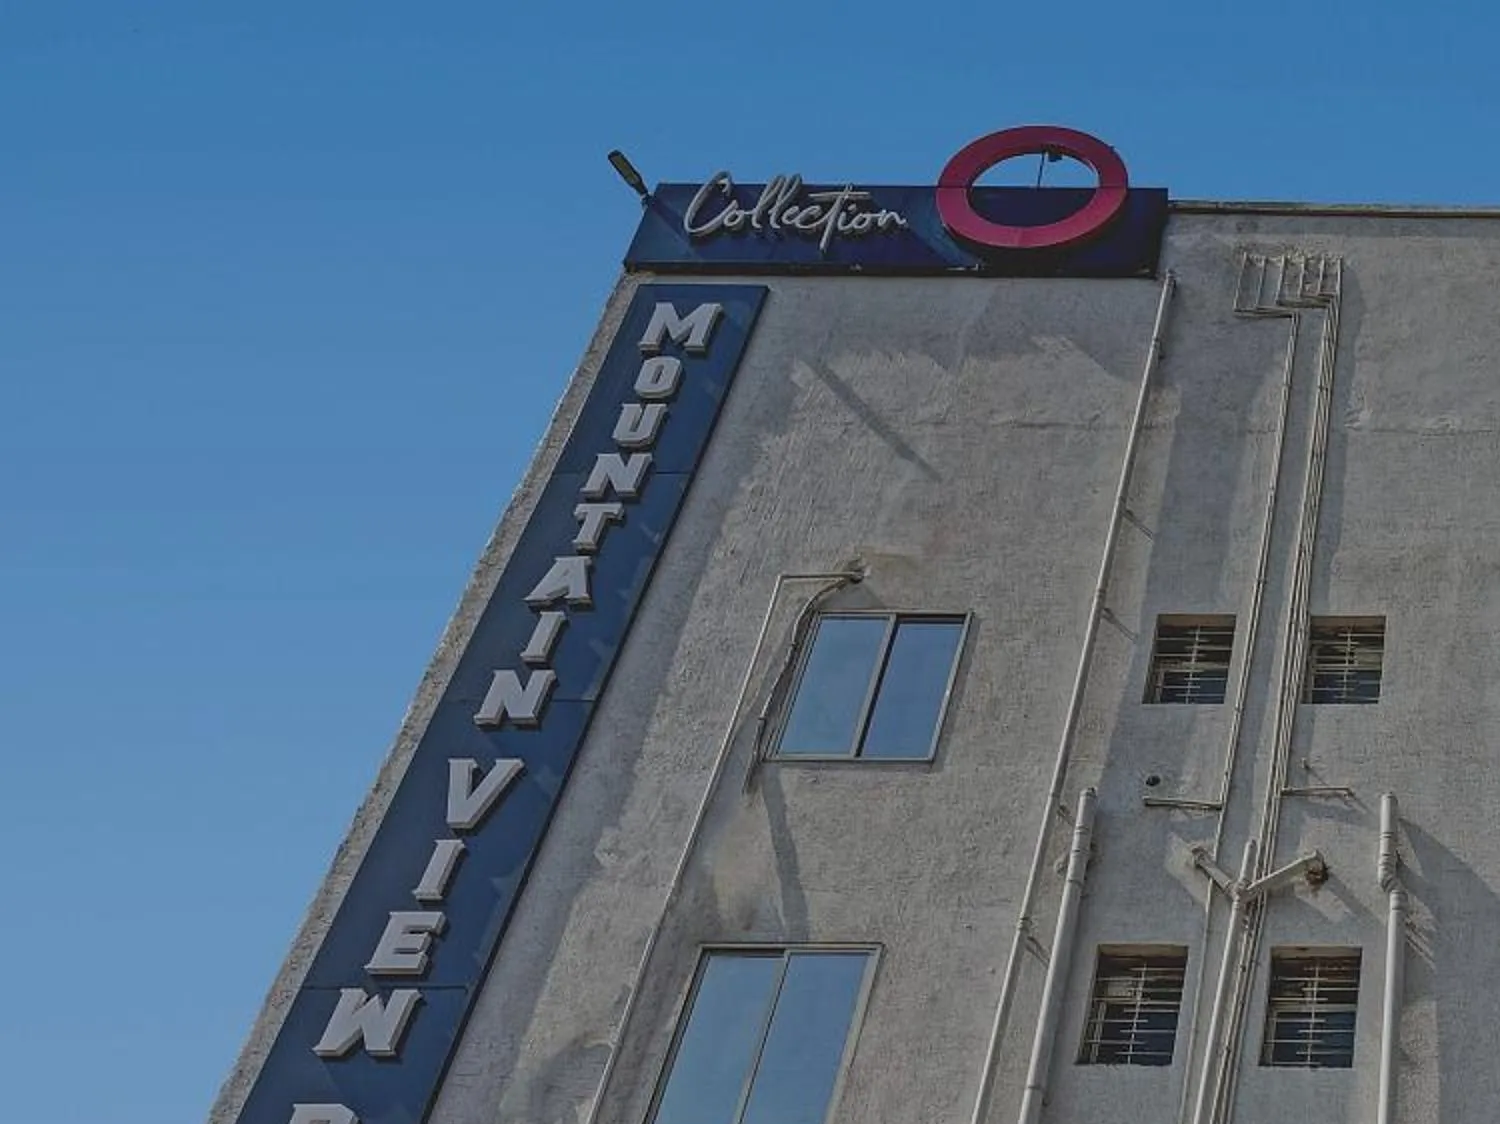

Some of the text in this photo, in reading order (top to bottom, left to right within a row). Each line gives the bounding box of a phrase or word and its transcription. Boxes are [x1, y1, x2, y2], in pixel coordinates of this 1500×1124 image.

[683, 170, 909, 255] Collection
[474, 301, 724, 728] MOUNTAIN
[312, 757, 526, 1058] VIEW
